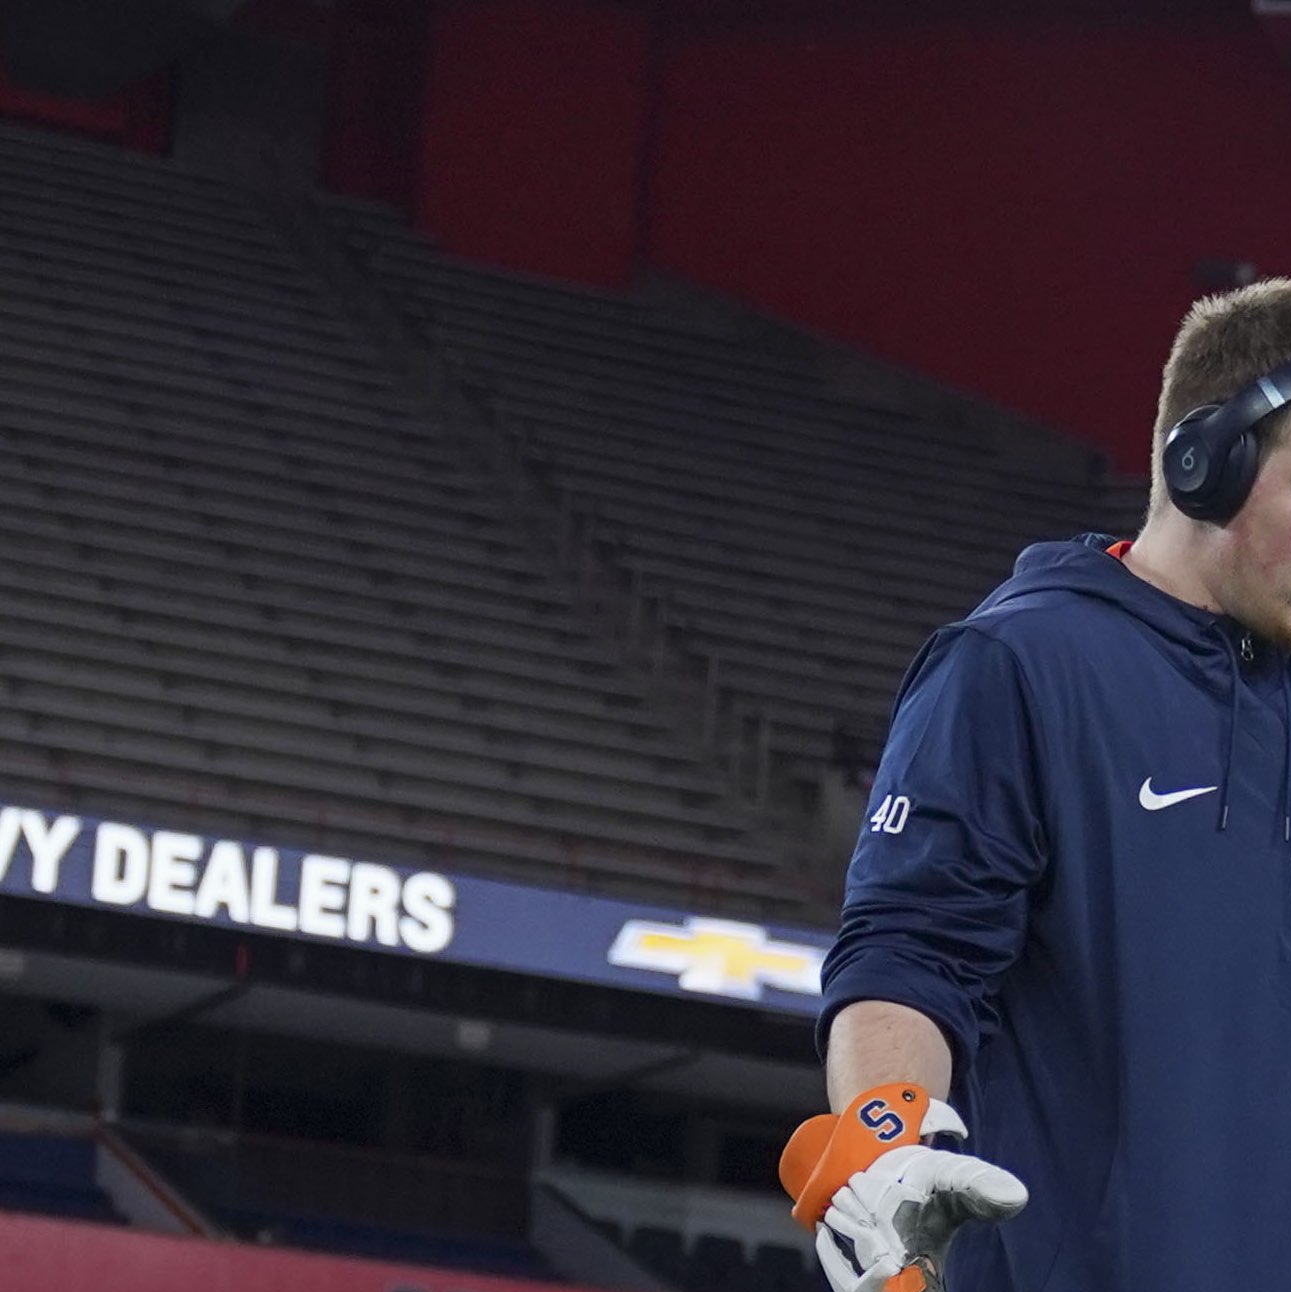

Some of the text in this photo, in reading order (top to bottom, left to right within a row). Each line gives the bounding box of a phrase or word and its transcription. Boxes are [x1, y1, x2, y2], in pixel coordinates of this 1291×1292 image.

[870, 794, 910, 834] 40
[91, 820, 456, 953] DEALERS
[857, 1098, 905, 1142] S
